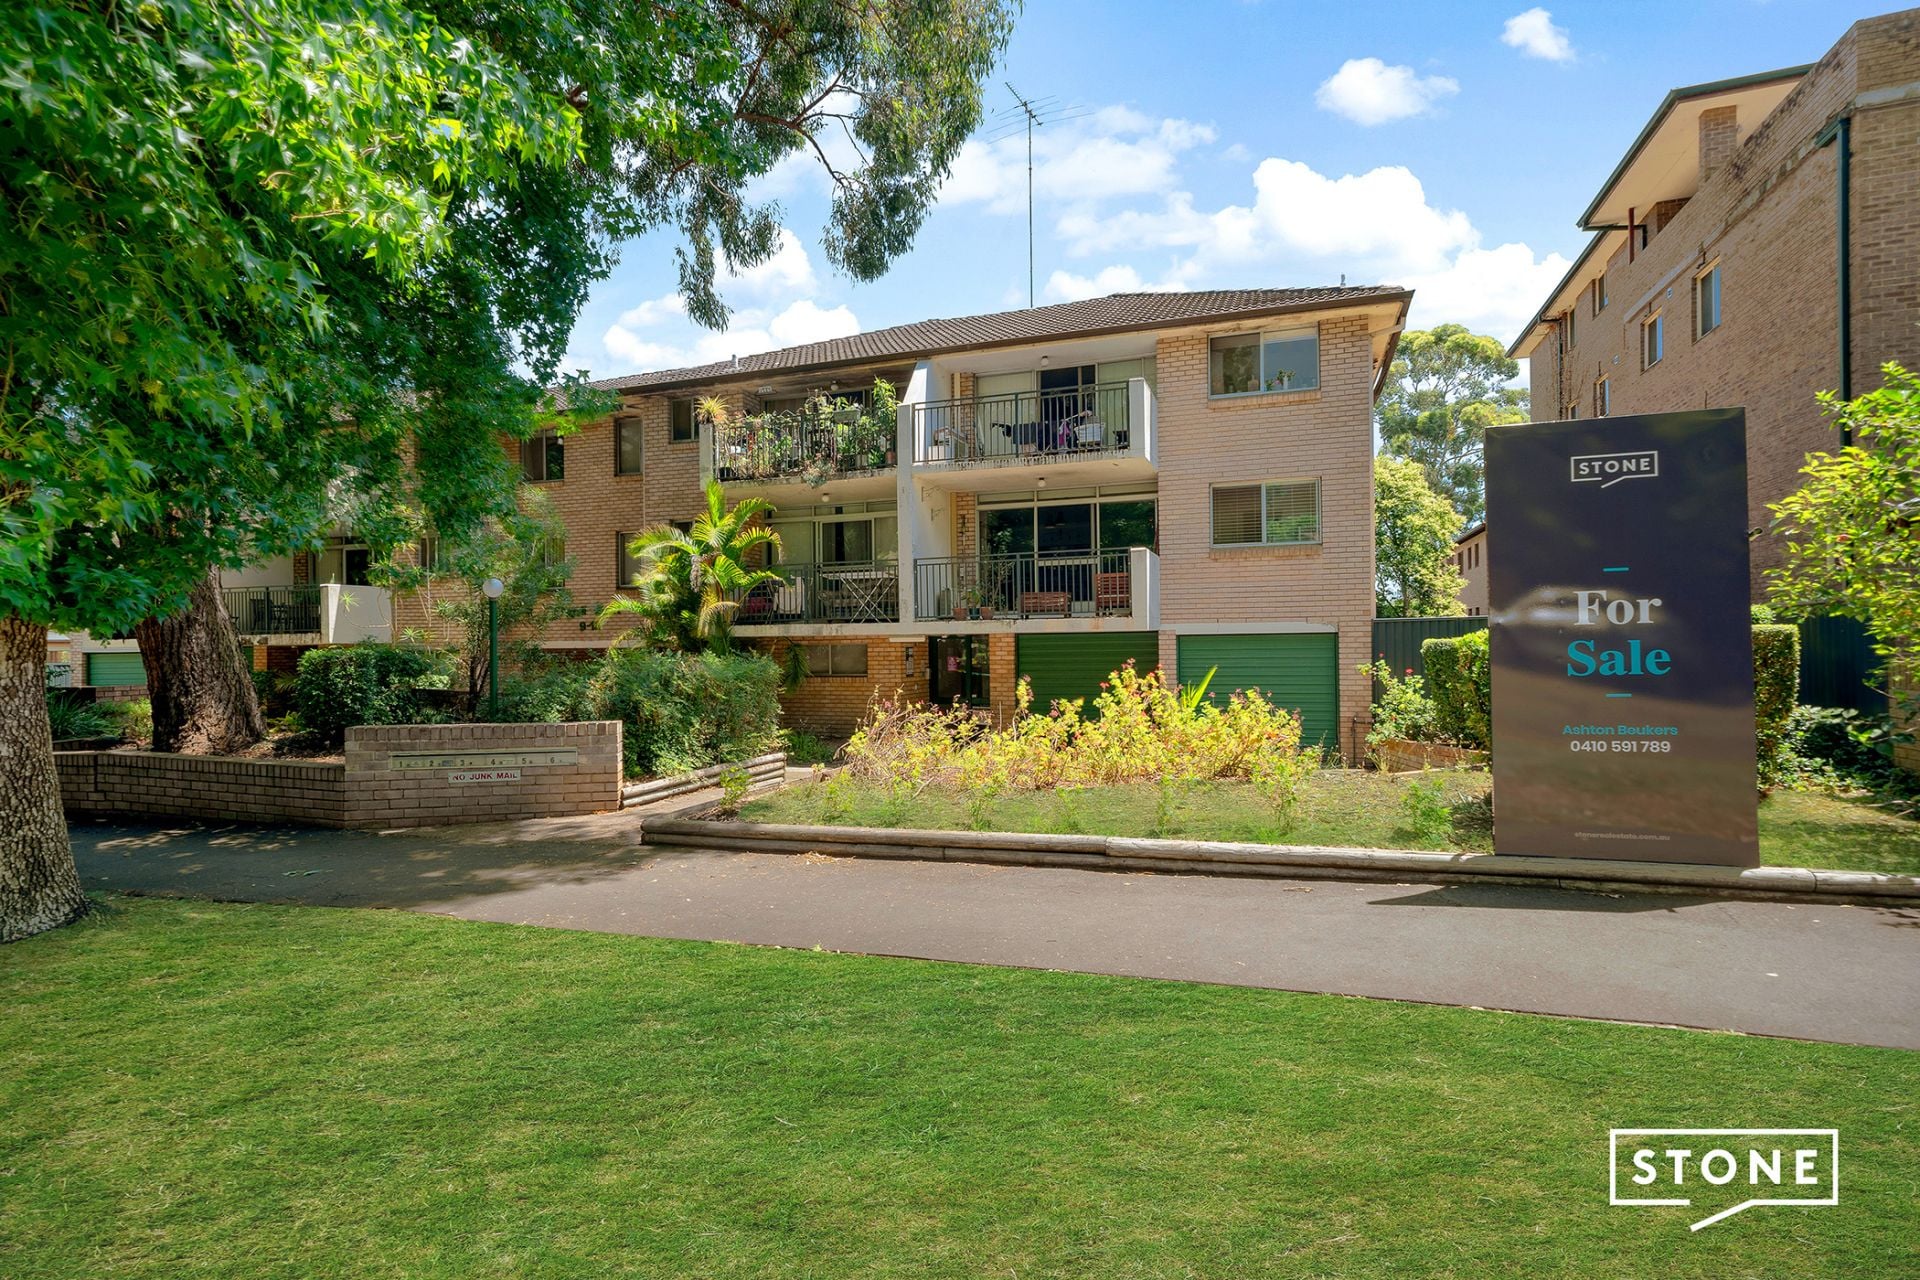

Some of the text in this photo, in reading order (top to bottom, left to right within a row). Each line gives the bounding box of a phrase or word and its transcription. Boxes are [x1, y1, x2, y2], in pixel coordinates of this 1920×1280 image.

[1579, 457, 1651, 475] STONE
[1573, 590, 1663, 626] For
[1567, 639, 1672, 677] Sale
[1562, 725, 1679, 736] Ashton Beukers
[1570, 740, 1671, 753] 0410 591 789
